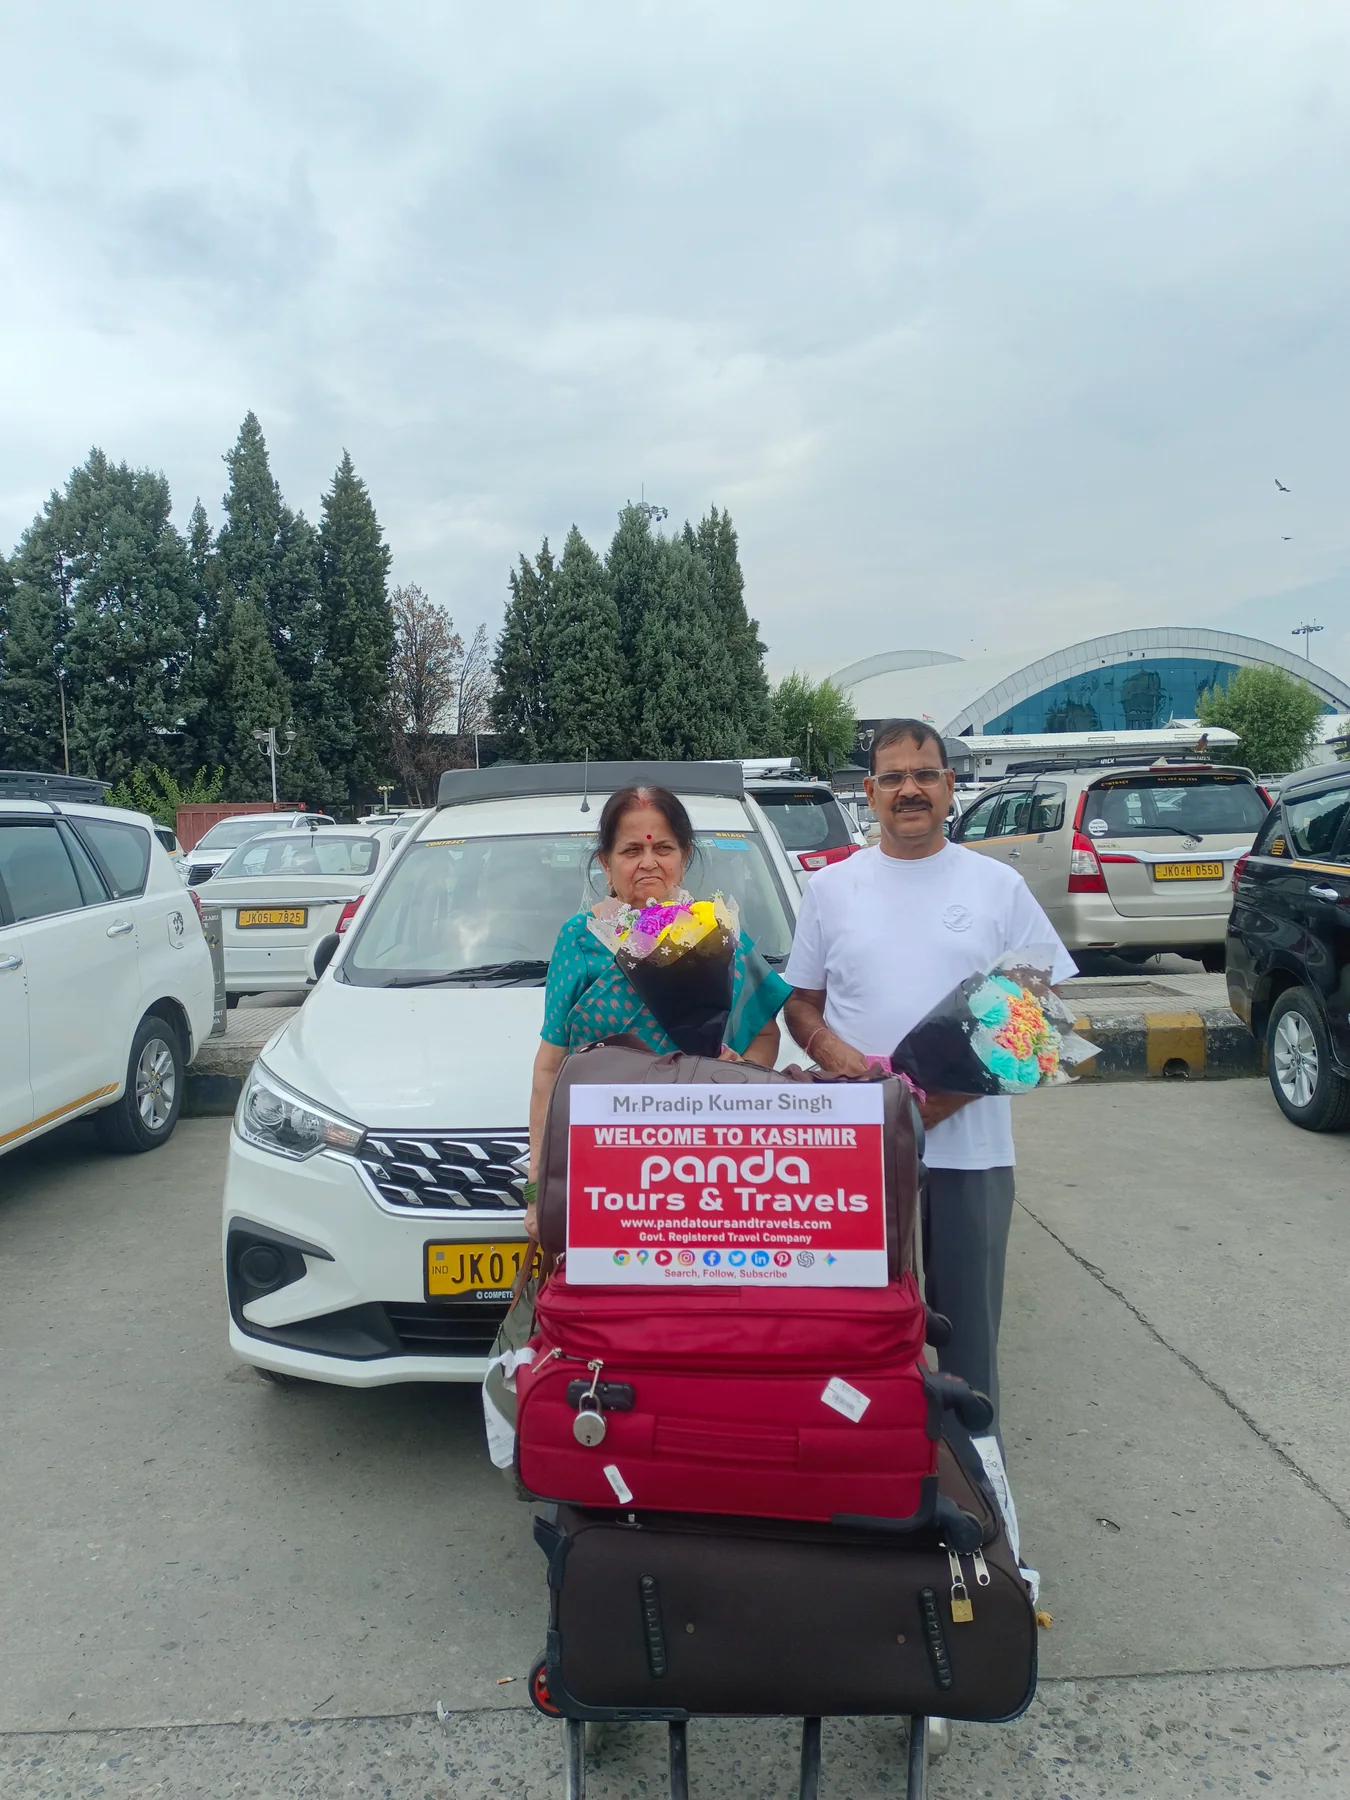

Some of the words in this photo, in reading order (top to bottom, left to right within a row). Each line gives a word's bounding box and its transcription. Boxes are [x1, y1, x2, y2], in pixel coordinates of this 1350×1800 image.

[425, 840, 466, 848] CONTRACT
[1162, 866, 1192, 877] JK04H
[1195, 864, 1219, 875] 0550
[246, 913, 274, 924] JK05L
[278, 912, 301, 923] 7825
[709, 1094, 773, 1112] Kumar
[777, 1093, 833, 1114] Singh
[594, 1127, 707, 1145] WELCOME
[713, 1127, 744, 1145] TO
[750, 1128, 858, 1146] KASHMIR
[640, 1149, 811, 1190] panda
[583, 1187, 686, 1211] Tours
[699, 1187, 725, 1212] &
[733, 1187, 869, 1213] Travels
[620, 1217, 832, 1231] www.pandatoursandtravels.com
[639, 1231, 666, 1242] Govt.
[668, 1232, 726, 1244] Registered
[727, 1232, 761, 1243] Travel
[763, 1232, 813, 1245] Company
[432, 1265, 449, 1275] IND
[664, 1268, 701, 1279] Search,
[702, 1269, 737, 1279] Follow,
[739, 1269, 788, 1279] Subscribe
